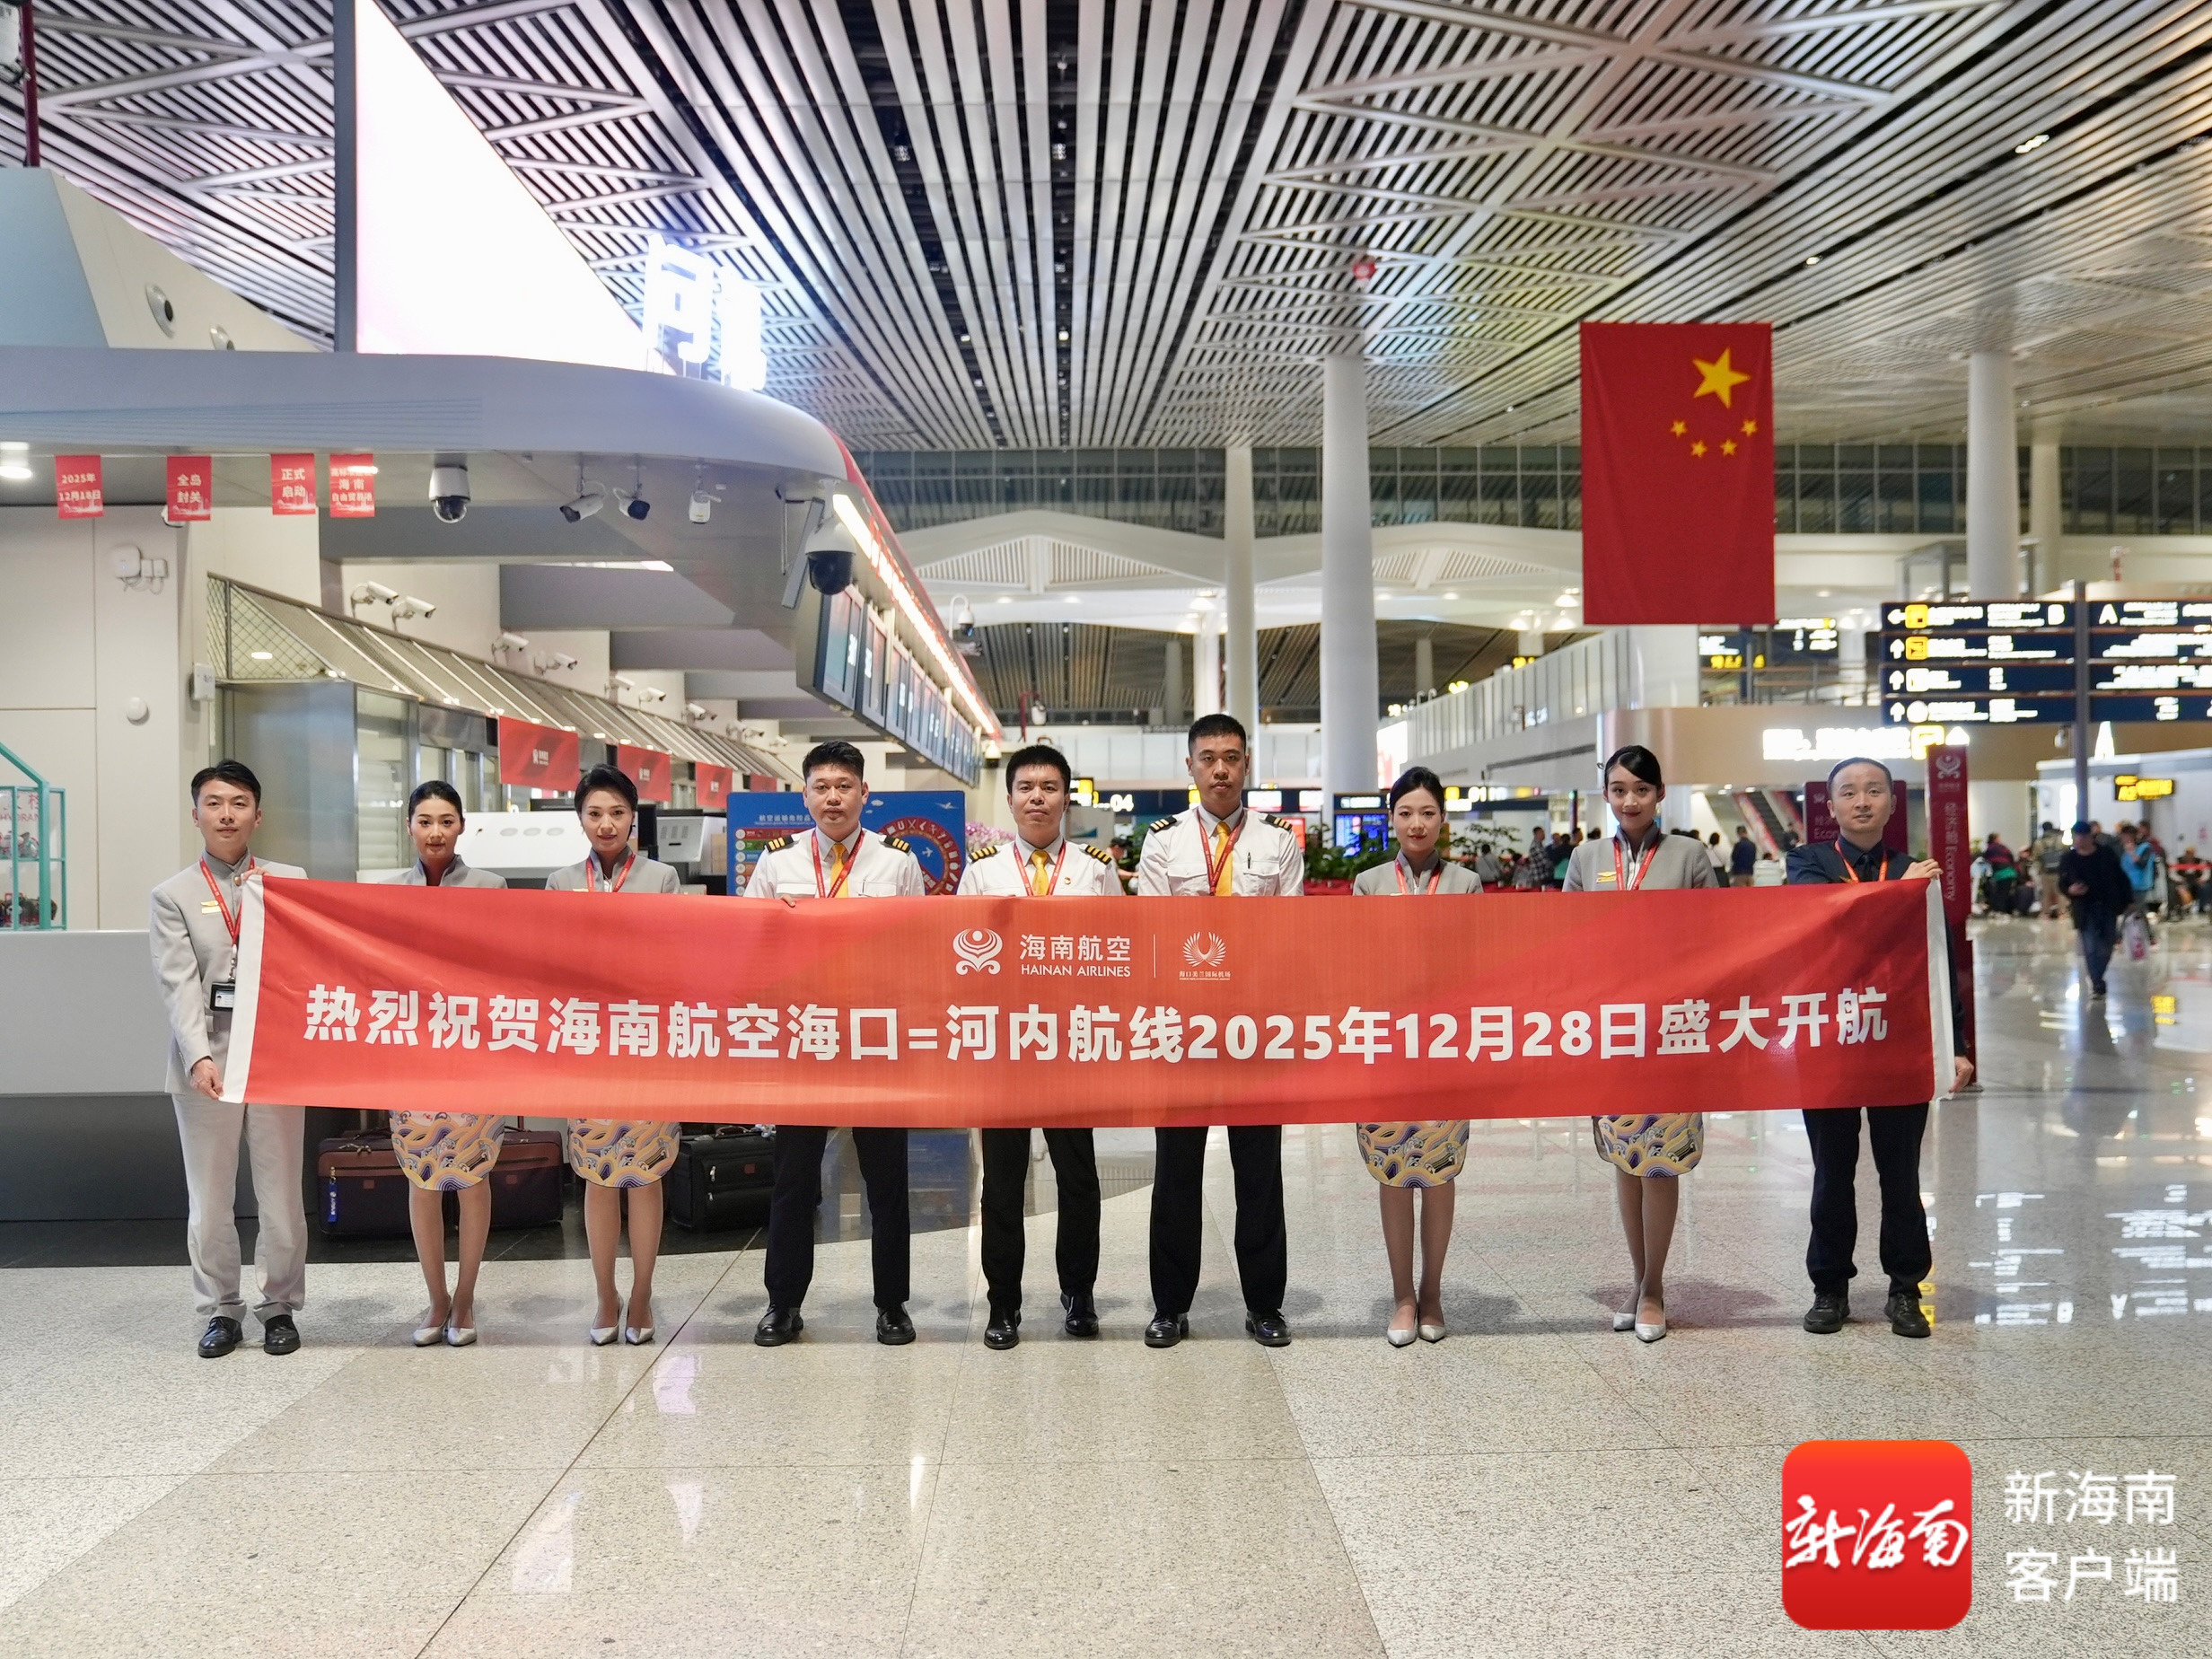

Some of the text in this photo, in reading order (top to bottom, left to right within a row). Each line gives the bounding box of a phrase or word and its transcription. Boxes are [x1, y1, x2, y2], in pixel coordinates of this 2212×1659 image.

[61, 472, 96, 485] 2025年
[177, 473, 202, 487] 全岛
[281, 468, 306, 481] 正式
[58, 489, 101, 503] 12月18日
[177, 490, 202, 504] 封关
[282, 485, 306, 498] 启动
[1110, 794, 1134, 812] 04
[1020, 934, 1131, 961] 海南航空
[1021, 963, 1131, 978] HAINAN AIRLINES
